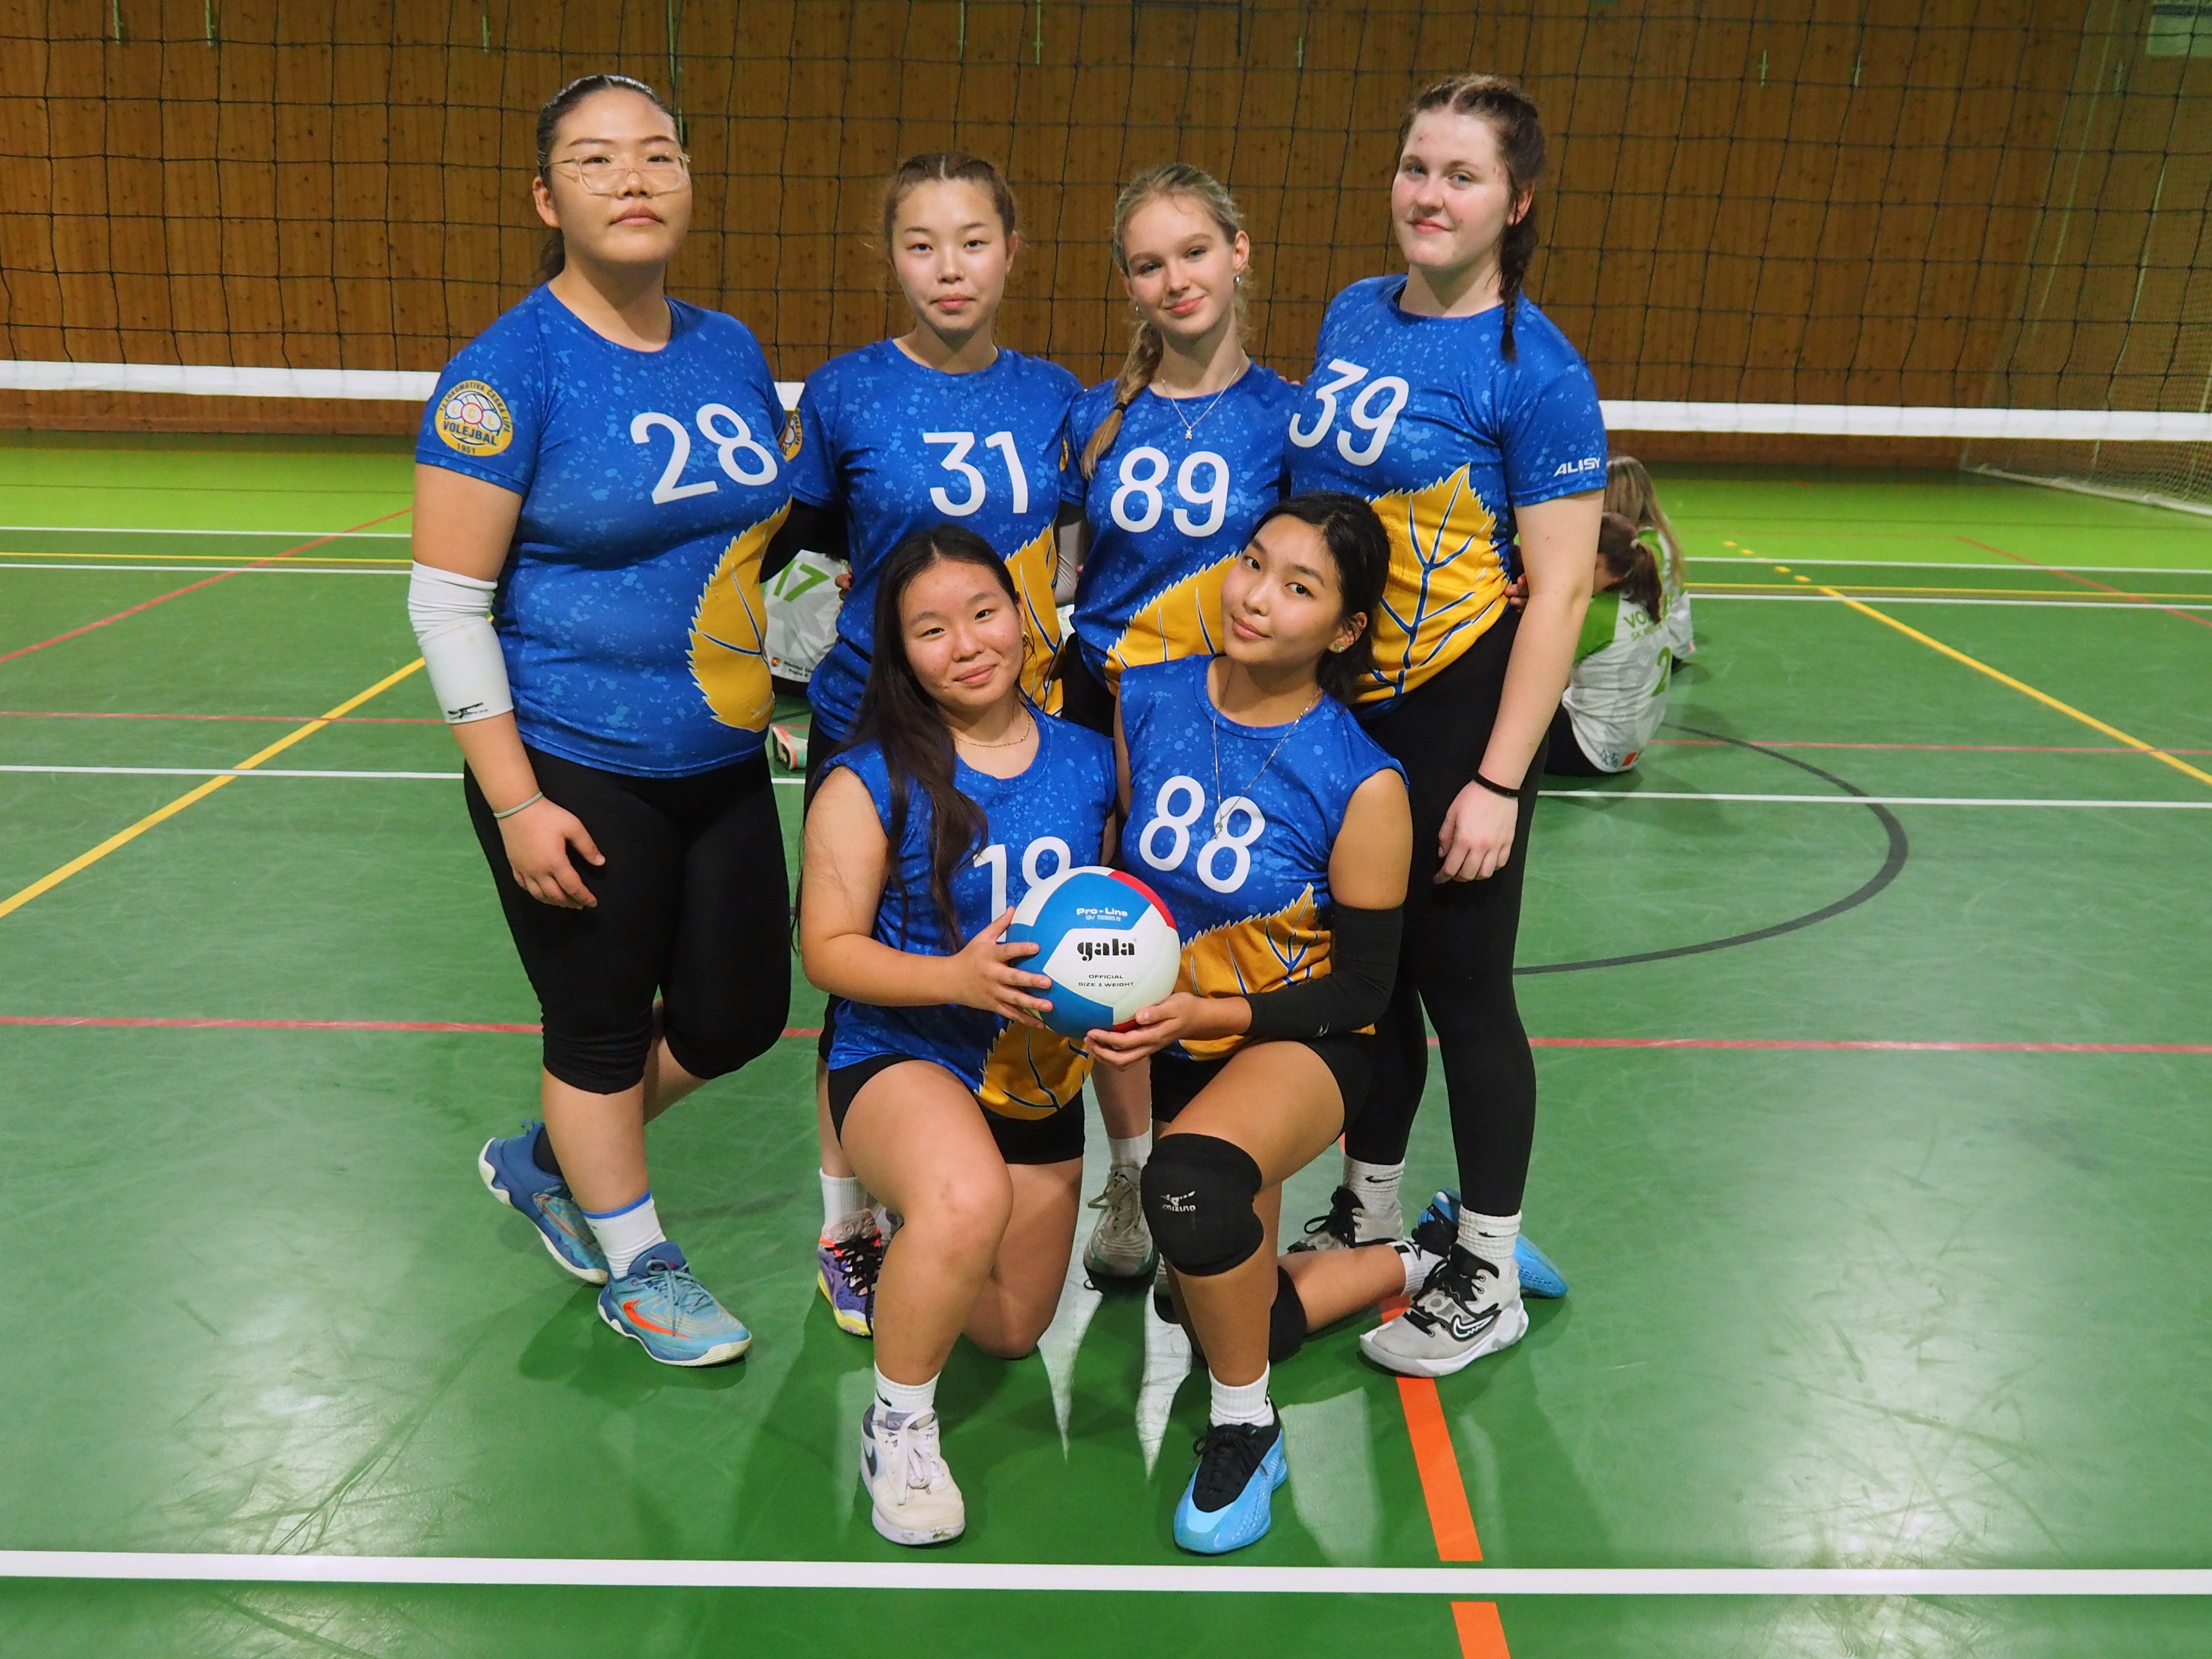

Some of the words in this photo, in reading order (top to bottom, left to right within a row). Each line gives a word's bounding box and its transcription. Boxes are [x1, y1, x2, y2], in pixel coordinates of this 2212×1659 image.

[444, 381, 485, 402] LOKOMOTIVA
[1289, 358, 1409, 466] 39
[444, 420, 497, 446] VOLEJBAL
[457, 443, 476, 454] 1951
[630, 403, 778, 504] 28
[922, 431, 1028, 516] 31
[1553, 457, 1601, 477] ALISY
[1110, 446, 1230, 537] 89
[773, 559, 831, 603] 17
[1139, 775, 1266, 894] 88
[1077, 938, 1135, 962] gala
